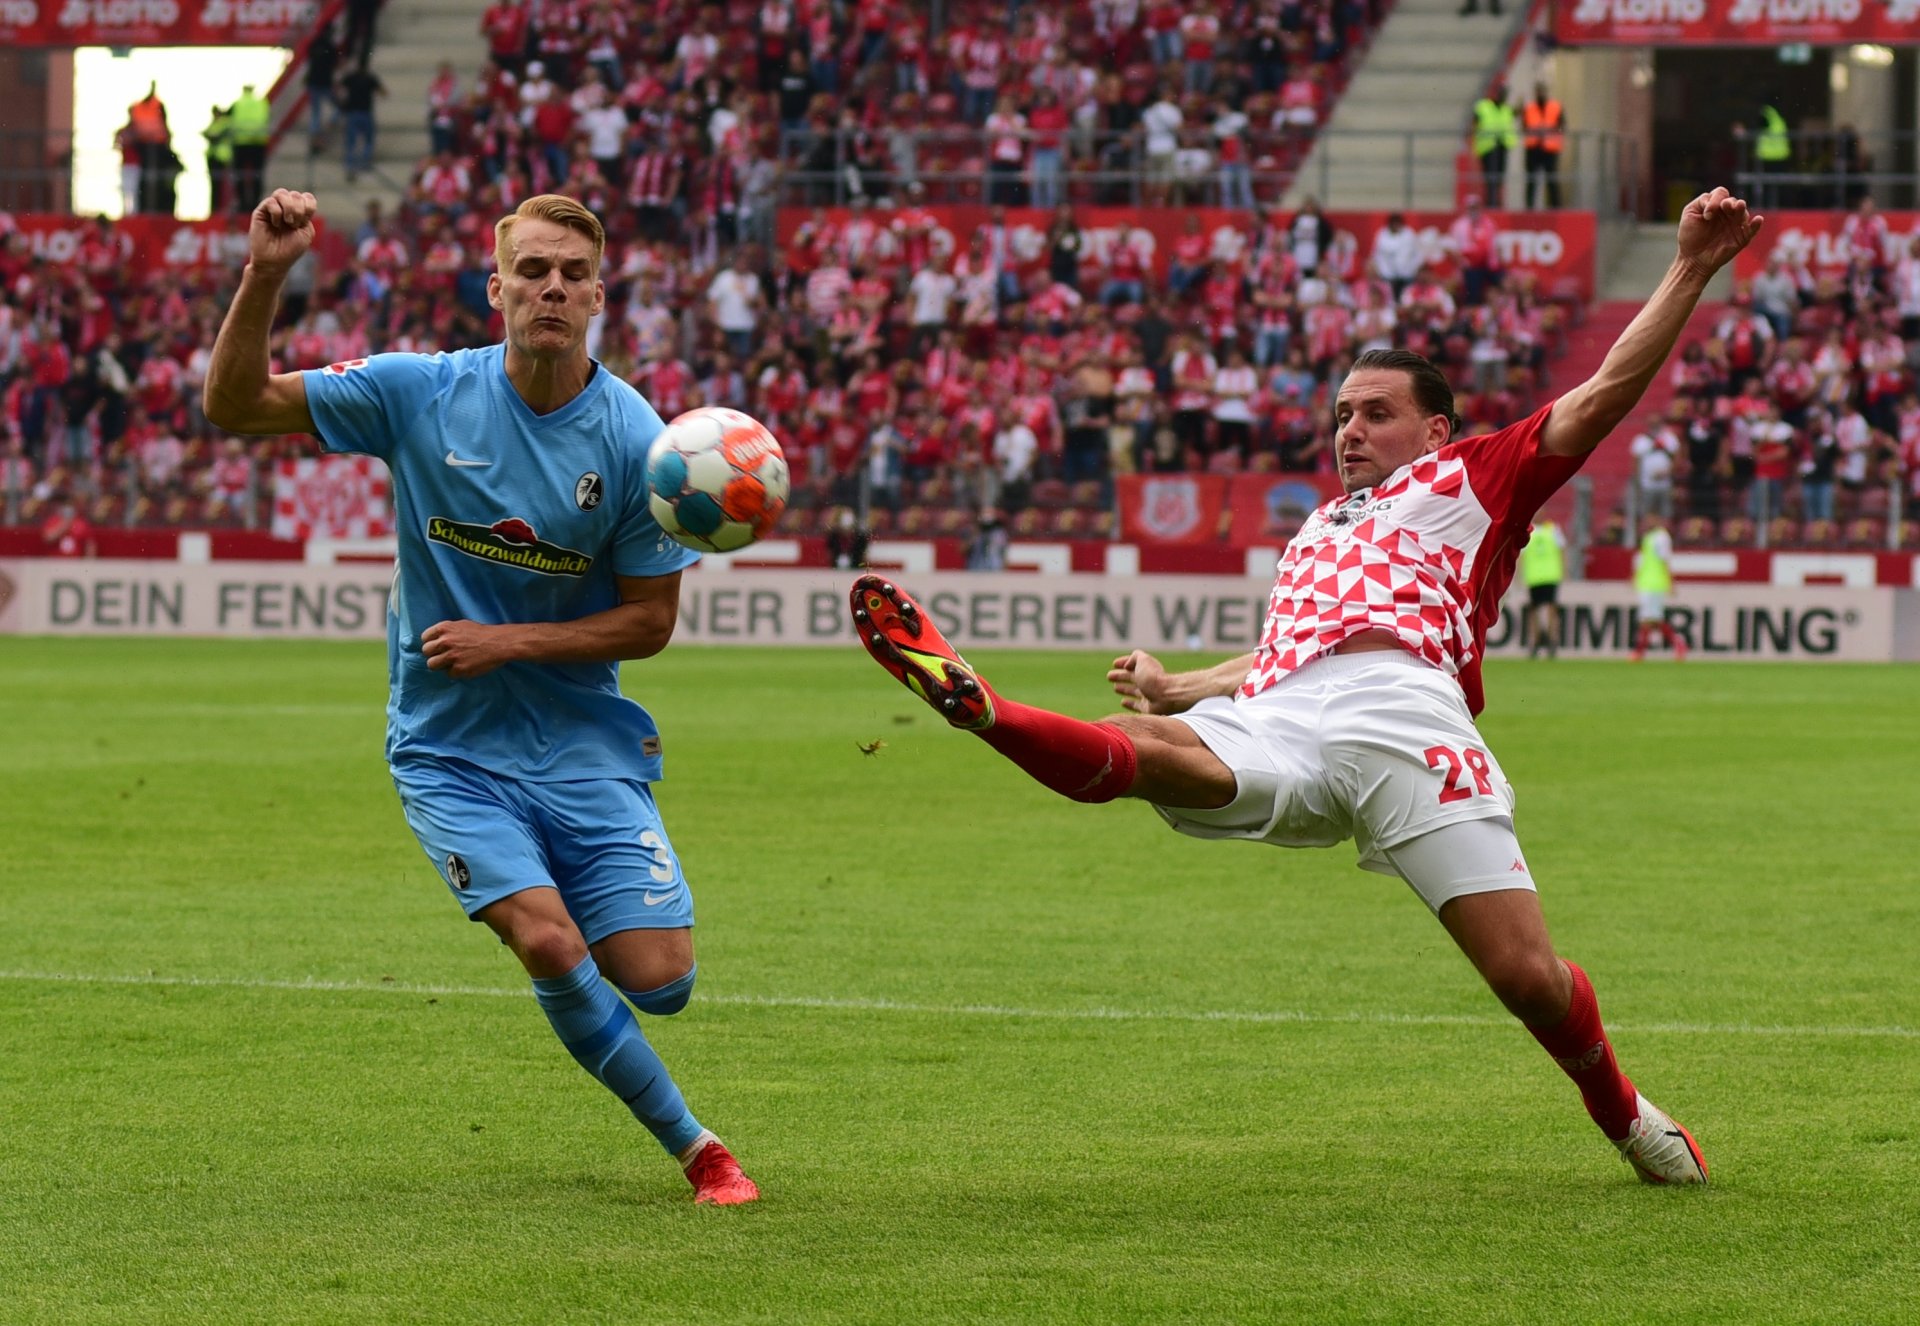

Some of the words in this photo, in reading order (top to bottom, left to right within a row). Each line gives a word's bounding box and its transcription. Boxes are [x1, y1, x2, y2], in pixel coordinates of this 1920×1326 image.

[96, 0, 179, 26] LOTTO
[1612, 0, 1705, 22] LOTTO
[1768, 0, 1863, 22] LOTTO
[430, 520, 588, 573] Schwarzwaldmilch
[51, 579, 184, 627] DEIN
[1423, 744, 1495, 805] 28
[640, 831, 674, 883] 3
